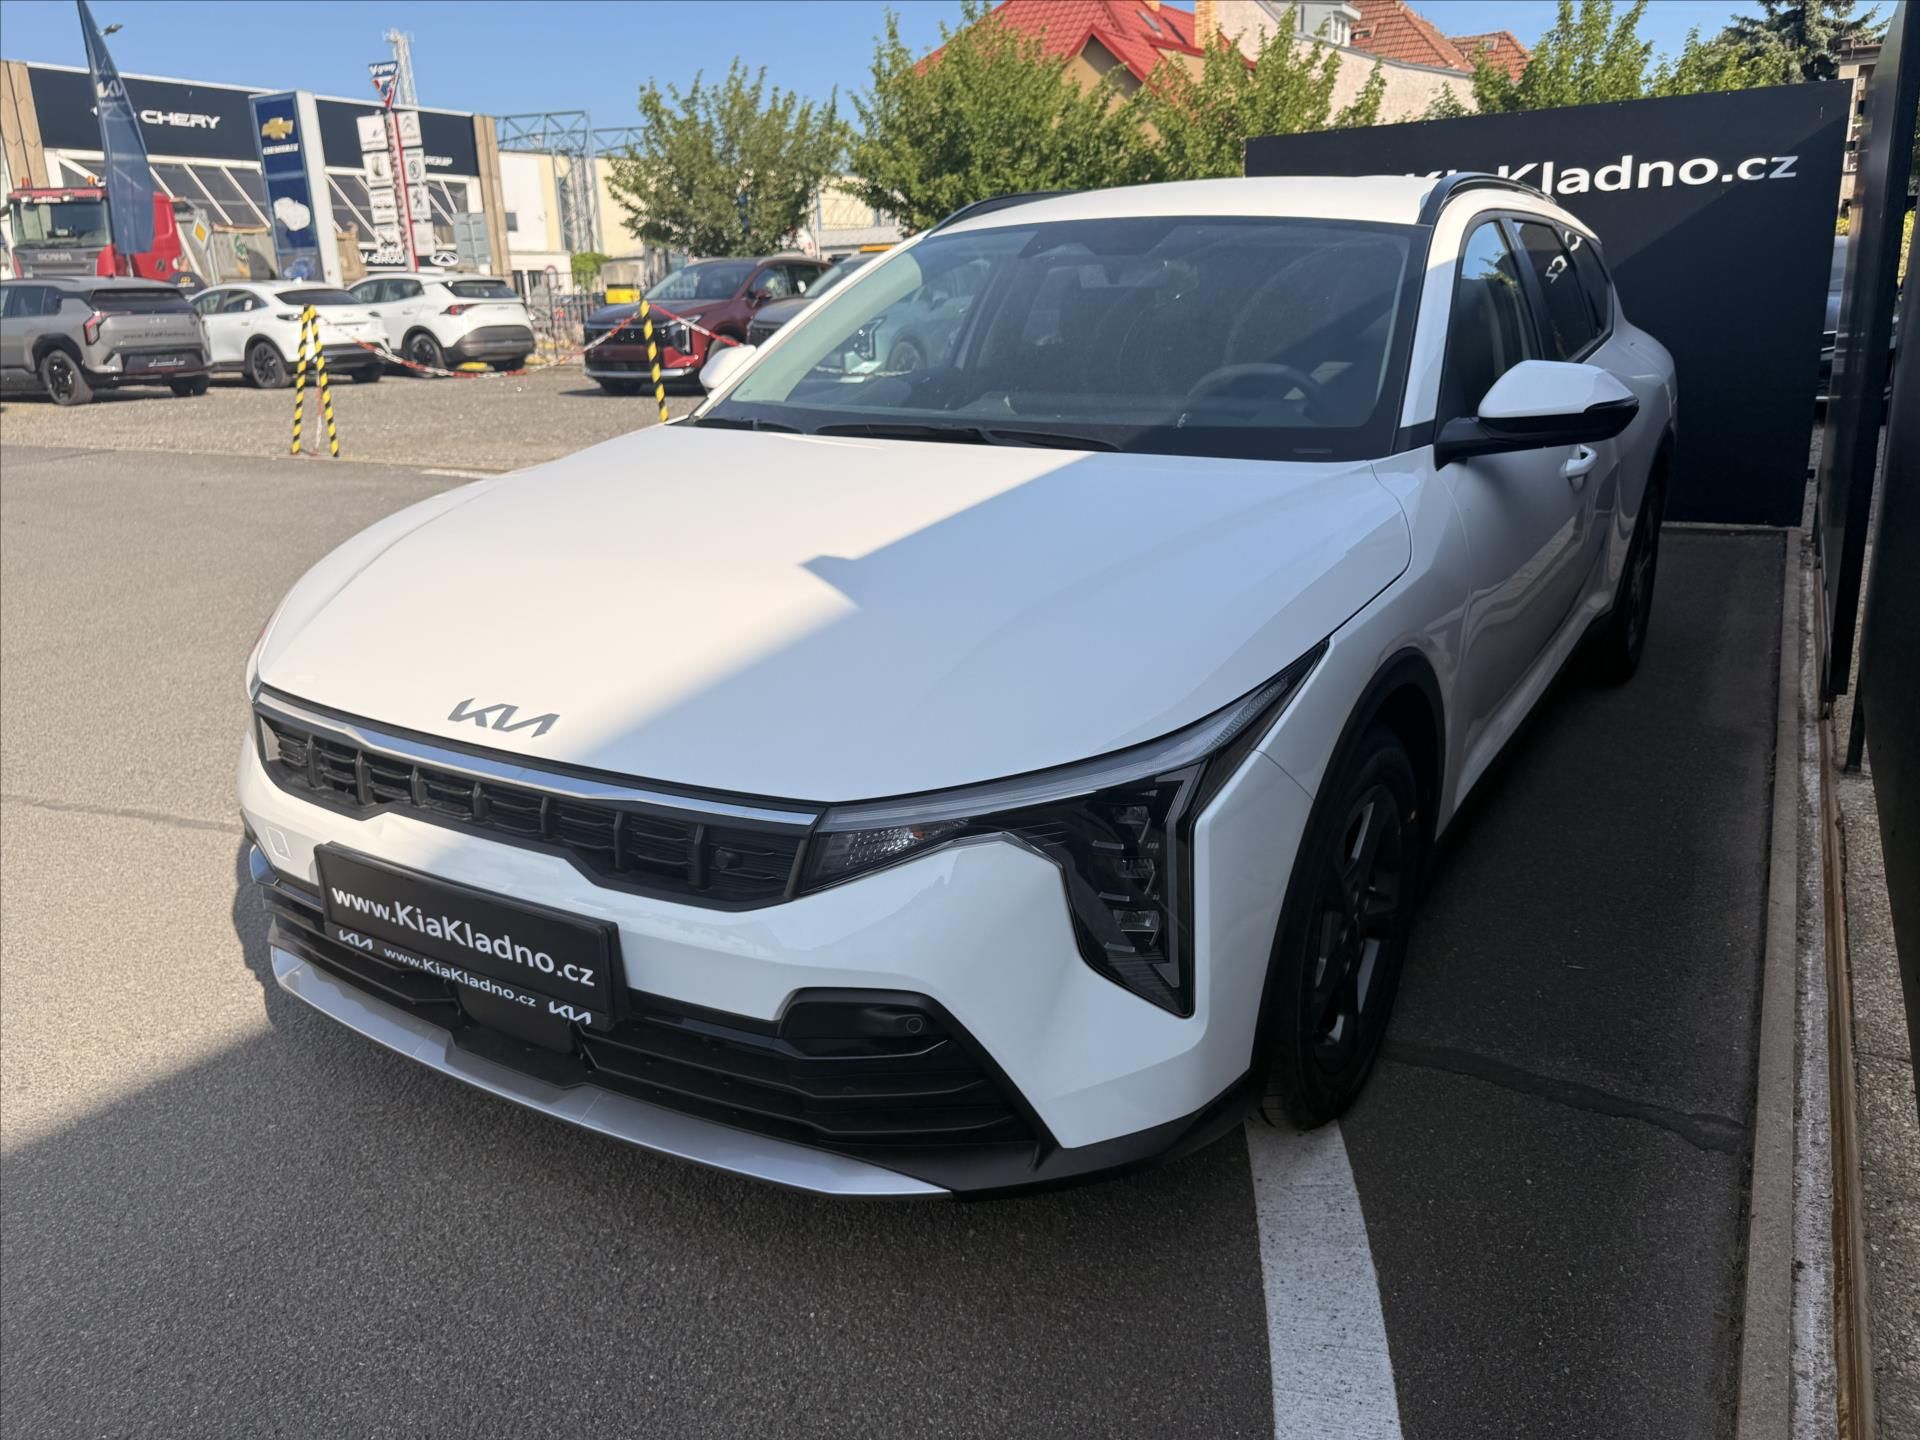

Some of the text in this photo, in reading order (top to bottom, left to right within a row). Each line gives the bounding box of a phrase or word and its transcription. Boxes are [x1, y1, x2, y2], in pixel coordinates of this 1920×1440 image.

[140, 109, 221, 129] CHERY
[447, 697, 561, 738] KIA
[331, 886, 596, 987] www.KiaKladno.cz
[338, 929, 592, 1025] KIA www.KiaKladno.cz KIA
